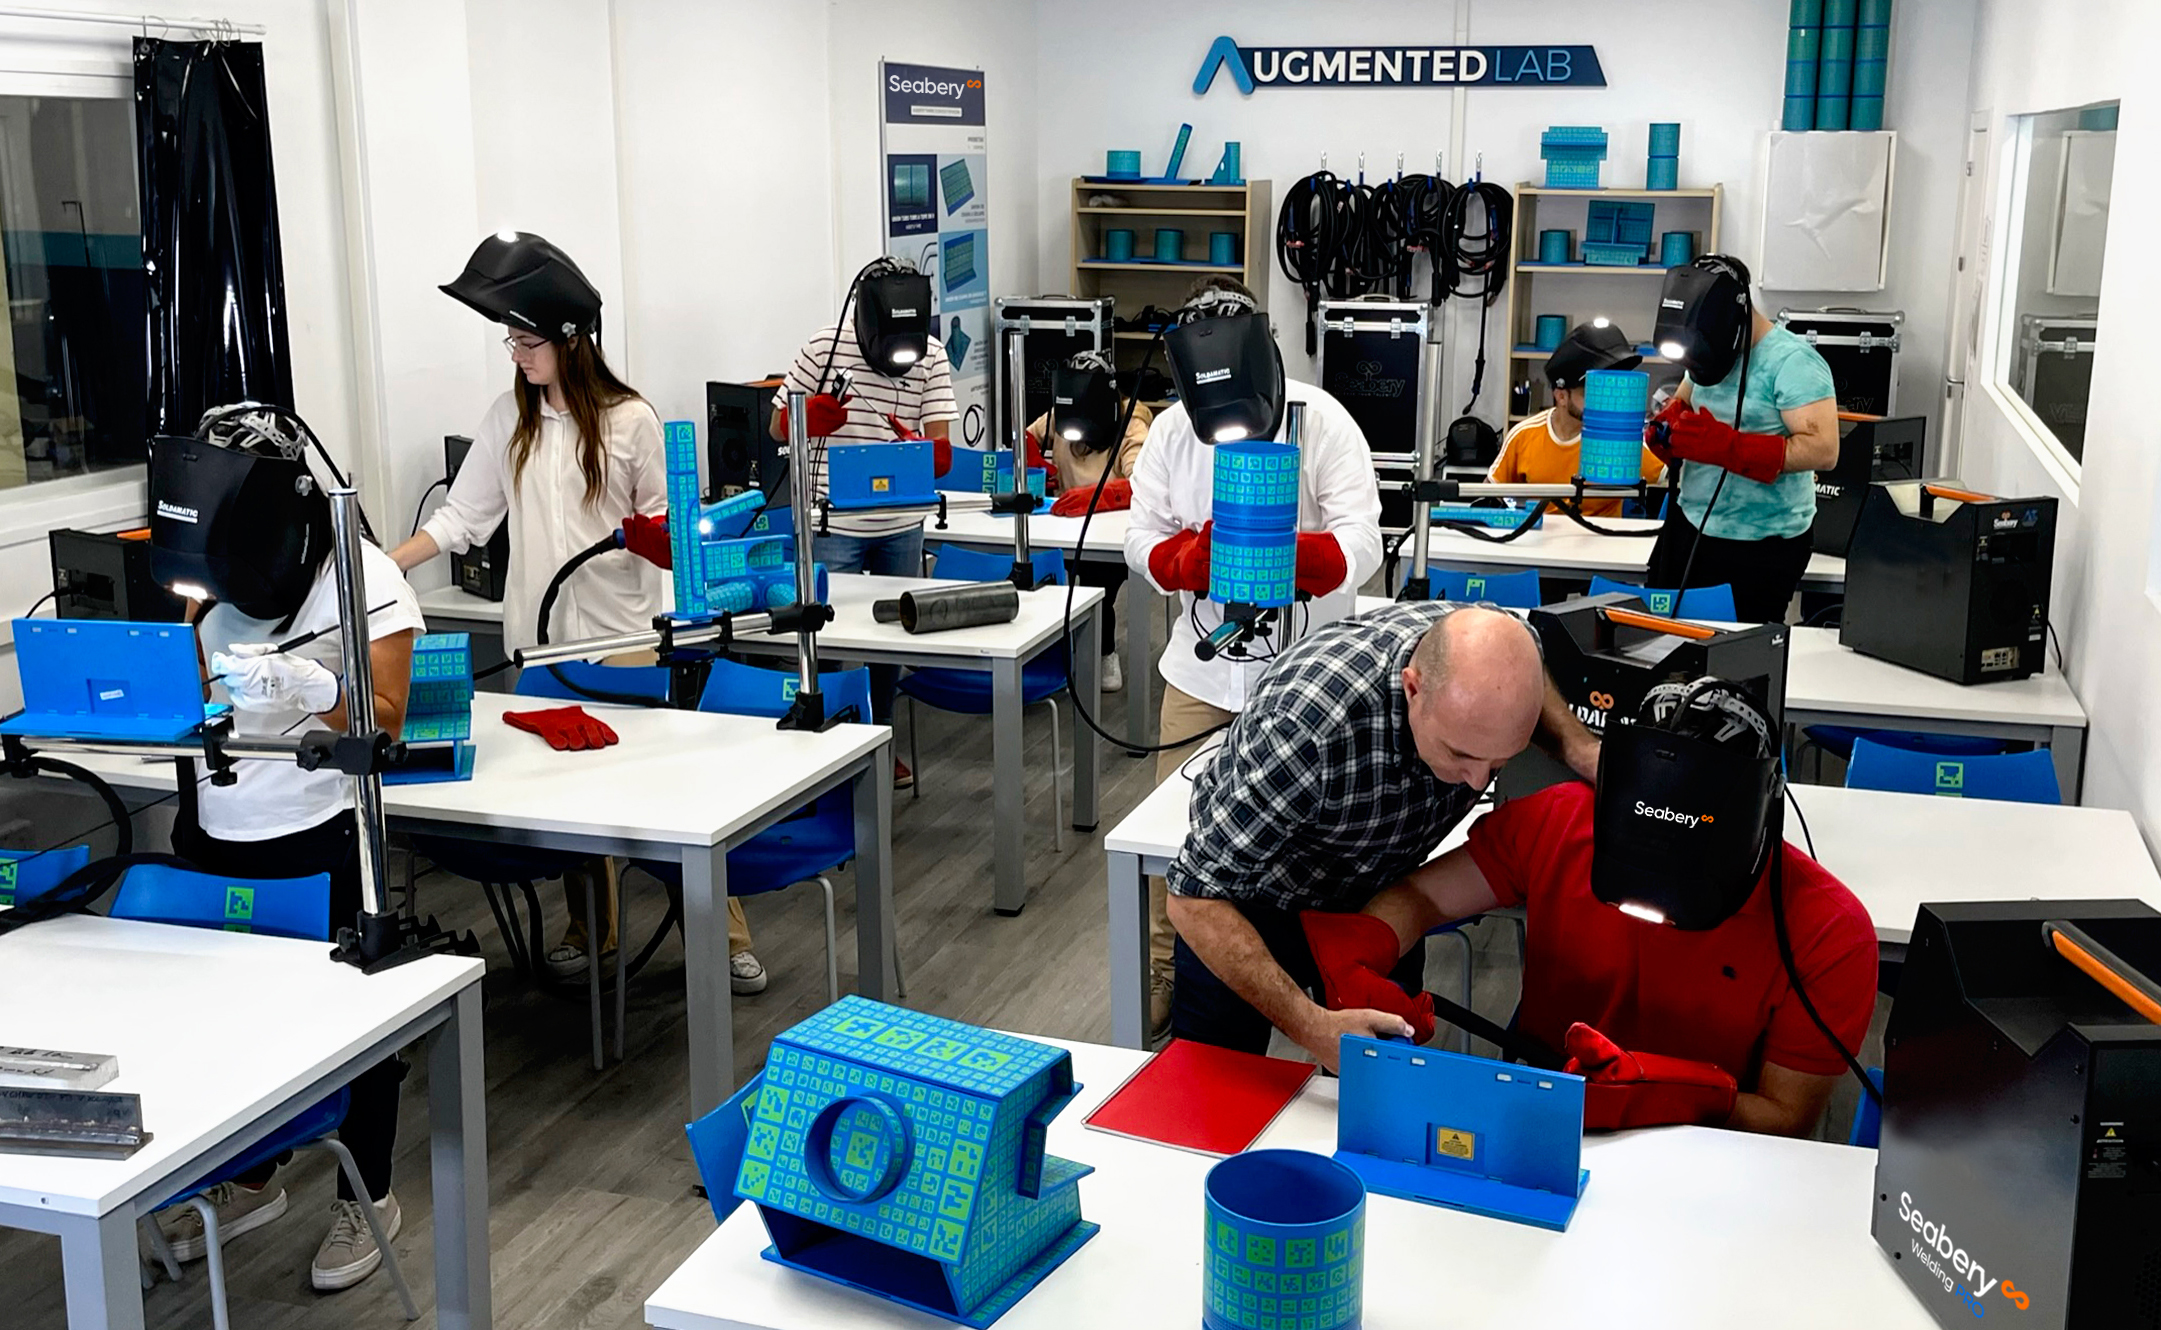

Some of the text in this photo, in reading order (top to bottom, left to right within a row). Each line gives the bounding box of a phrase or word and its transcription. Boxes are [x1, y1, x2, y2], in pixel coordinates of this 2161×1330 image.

[889, 75, 965, 99] Seabery
[1193, 36, 1571, 95] AUGMENTED LAB
[1634, 801, 1699, 828] Seabery
[1899, 1191, 1998, 1298] Seabery
[1911, 1238, 1985, 1319] Welding PRO
